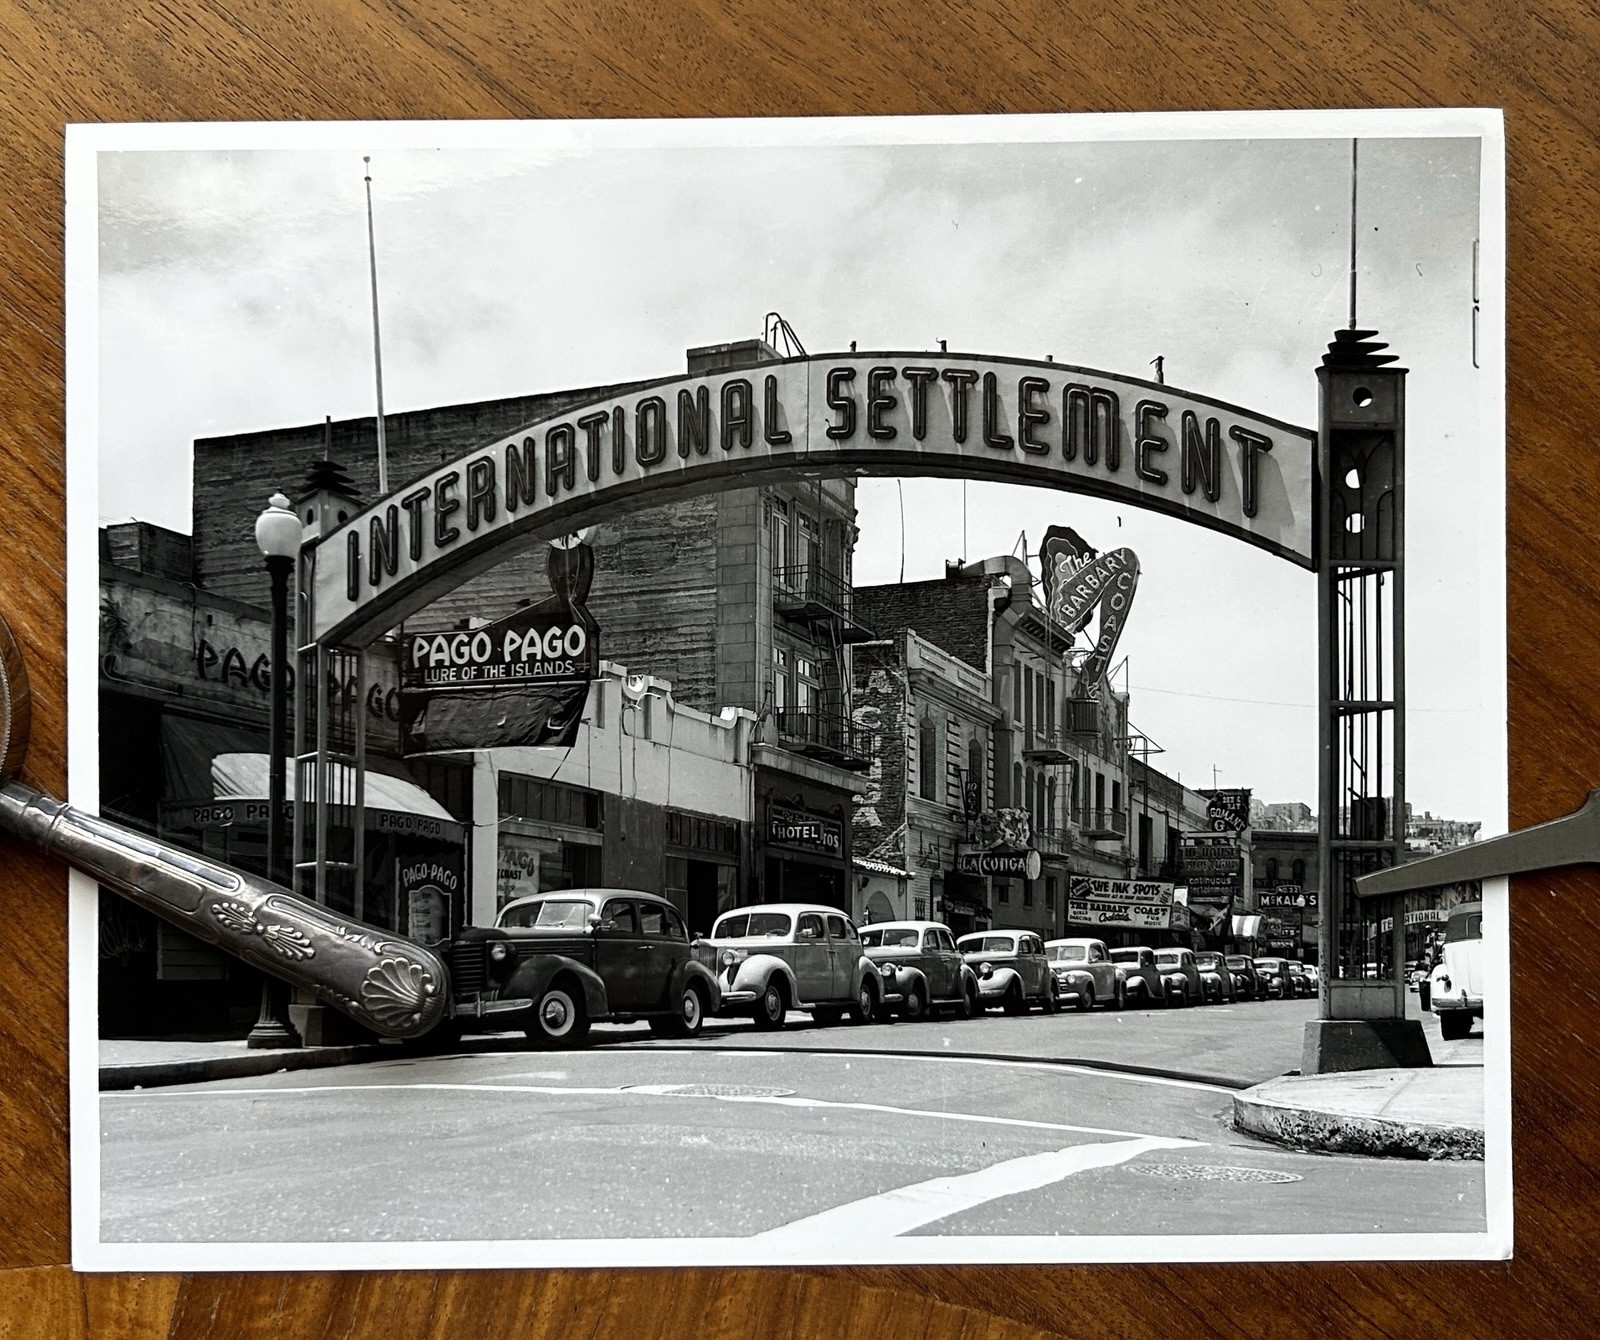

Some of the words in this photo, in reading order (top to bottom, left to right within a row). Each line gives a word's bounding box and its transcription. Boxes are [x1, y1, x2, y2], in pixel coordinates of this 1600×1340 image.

[347, 374, 792, 602] INTERNATIONAL
[826, 366, 1273, 518] SETTLEMENT
[1059, 552, 1092, 575] The
[1061, 548, 1128, 619] BARBARY
[1094, 571, 1132, 673] COAST
[412, 630, 492, 668] PAGO
[503, 624, 586, 663] PAGO
[424, 667, 457, 682] LURE
[462, 665, 478, 679] OF
[482, 664, 506, 678] THE
[511, 660, 573, 676] ISLANDS
[193, 806, 234, 822] PAGO
[246, 804, 294, 820] PAO
[380, 814, 412, 829] PAGO
[417, 819, 441, 835] PAGO
[778, 826, 818, 838] HOTEL
[983, 857, 1026, 872] CONGA
[402, 863, 457, 890] PAGO-PAGO
[1091, 880, 1109, 892] THE
[1112, 882, 1130, 894] INK
[1133, 884, 1161, 895] SPOTS
[1070, 901, 1088, 910] THE
[1089, 903, 1130, 913] BARBARY
[1134, 907, 1168, 916] COAST
[1261, 894, 1317, 906] McKAL'S
